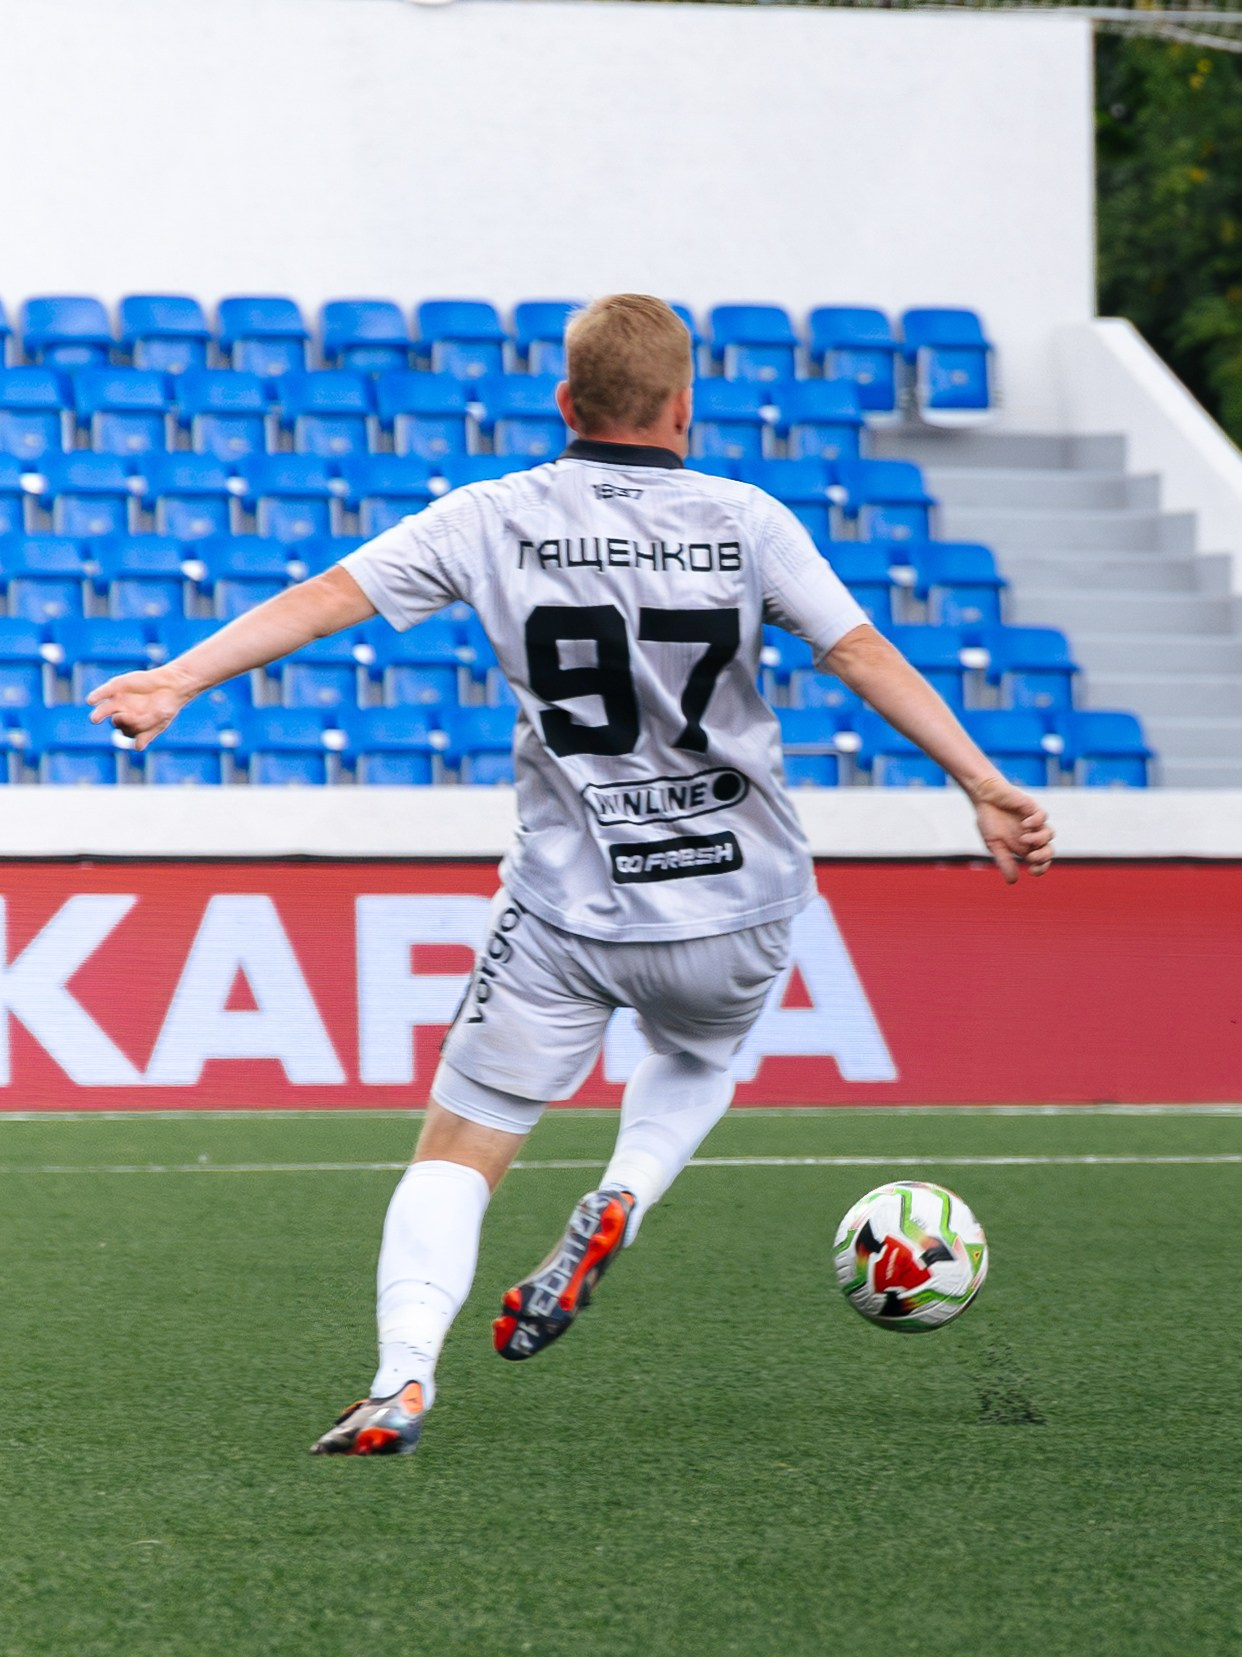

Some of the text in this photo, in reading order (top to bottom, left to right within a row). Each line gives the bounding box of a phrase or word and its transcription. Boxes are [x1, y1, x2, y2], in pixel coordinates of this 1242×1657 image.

[517, 537, 742, 574] ГАЩЕНКОВ
[525, 604, 740, 757] 97
[0, 893, 898, 1085] КАРА
